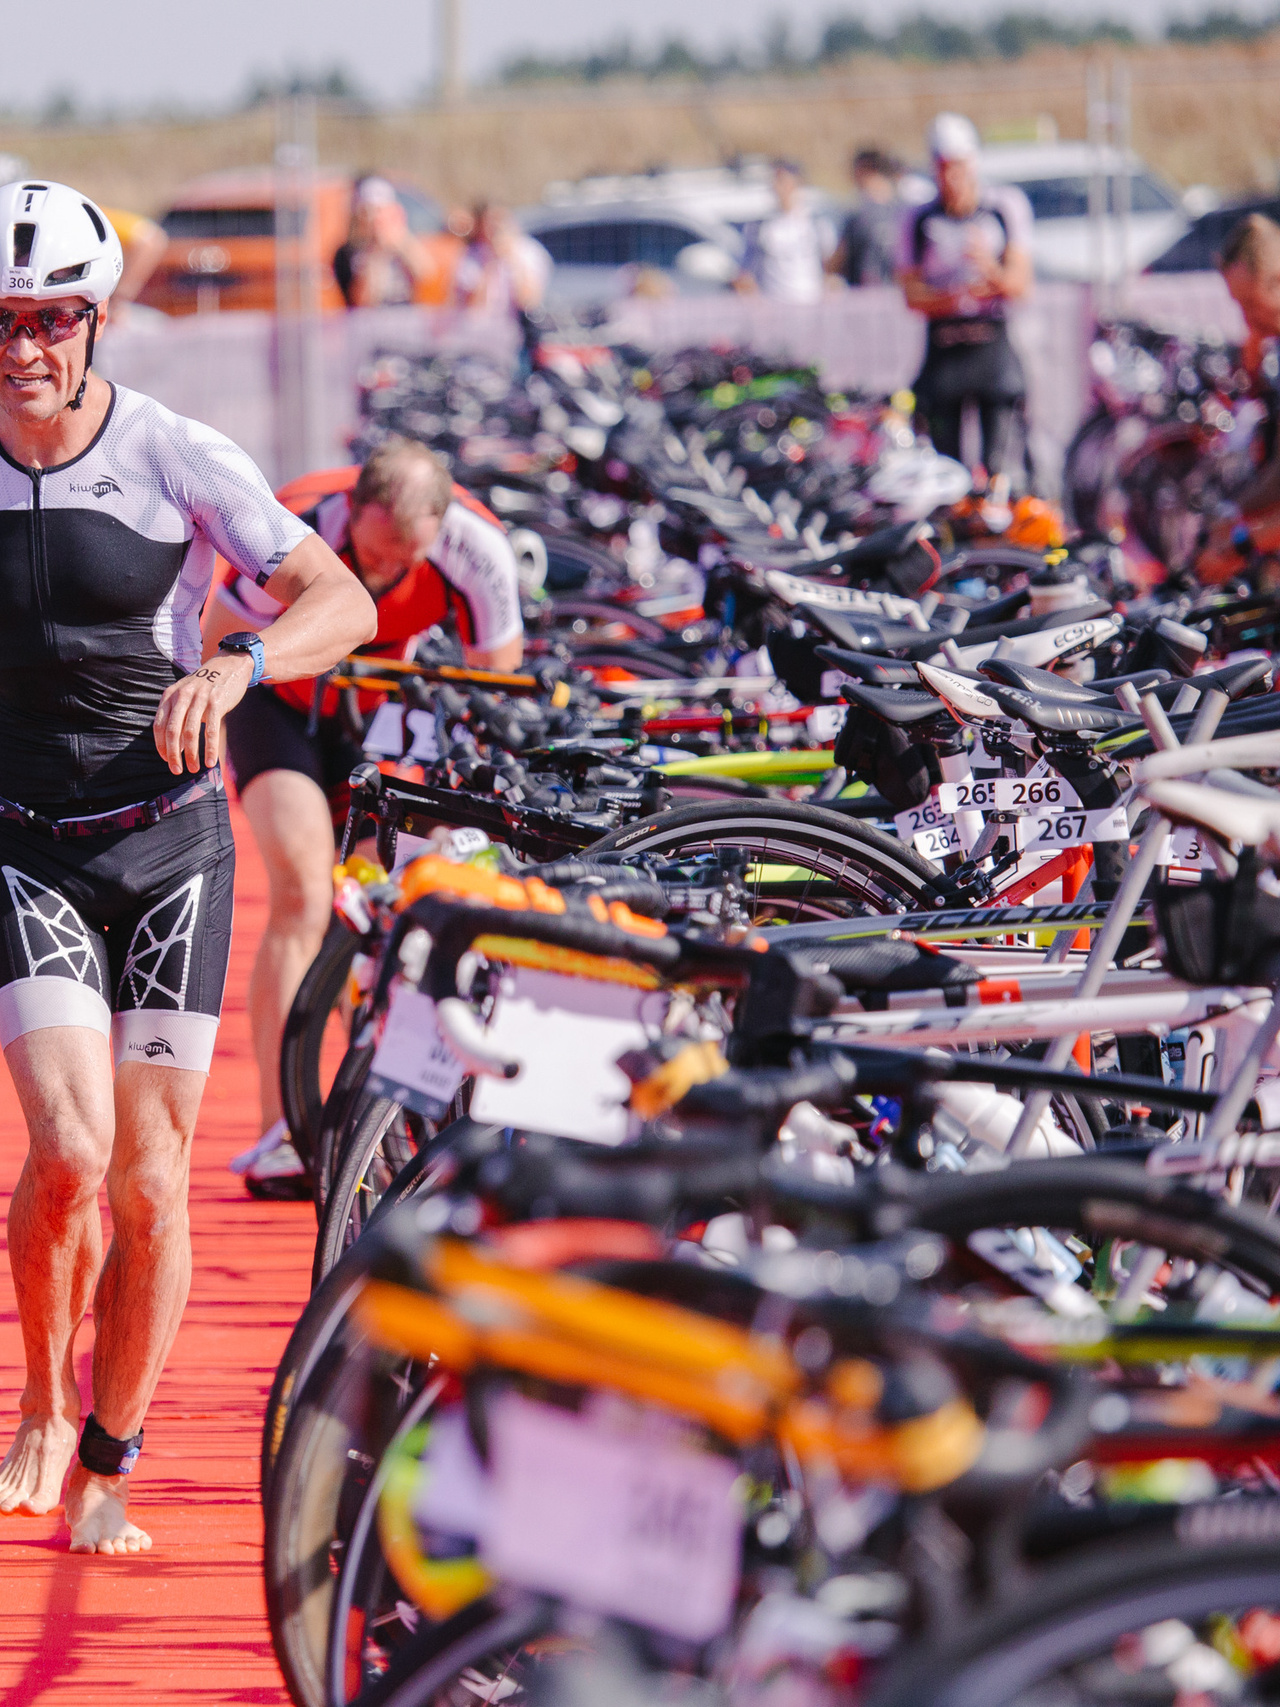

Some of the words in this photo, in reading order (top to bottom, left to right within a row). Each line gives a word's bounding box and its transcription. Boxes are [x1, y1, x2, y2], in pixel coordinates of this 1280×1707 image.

[8, 277, 34, 289] 306
[69, 482, 113, 493] kiwami
[1054, 622, 1095, 648] EC90
[1012, 781, 1061, 804] 266
[615, 826, 650, 848] 5000
[1037, 815, 1087, 841] 267
[925, 827, 961, 852] 264
[128, 1041, 167, 1054] kiwami
